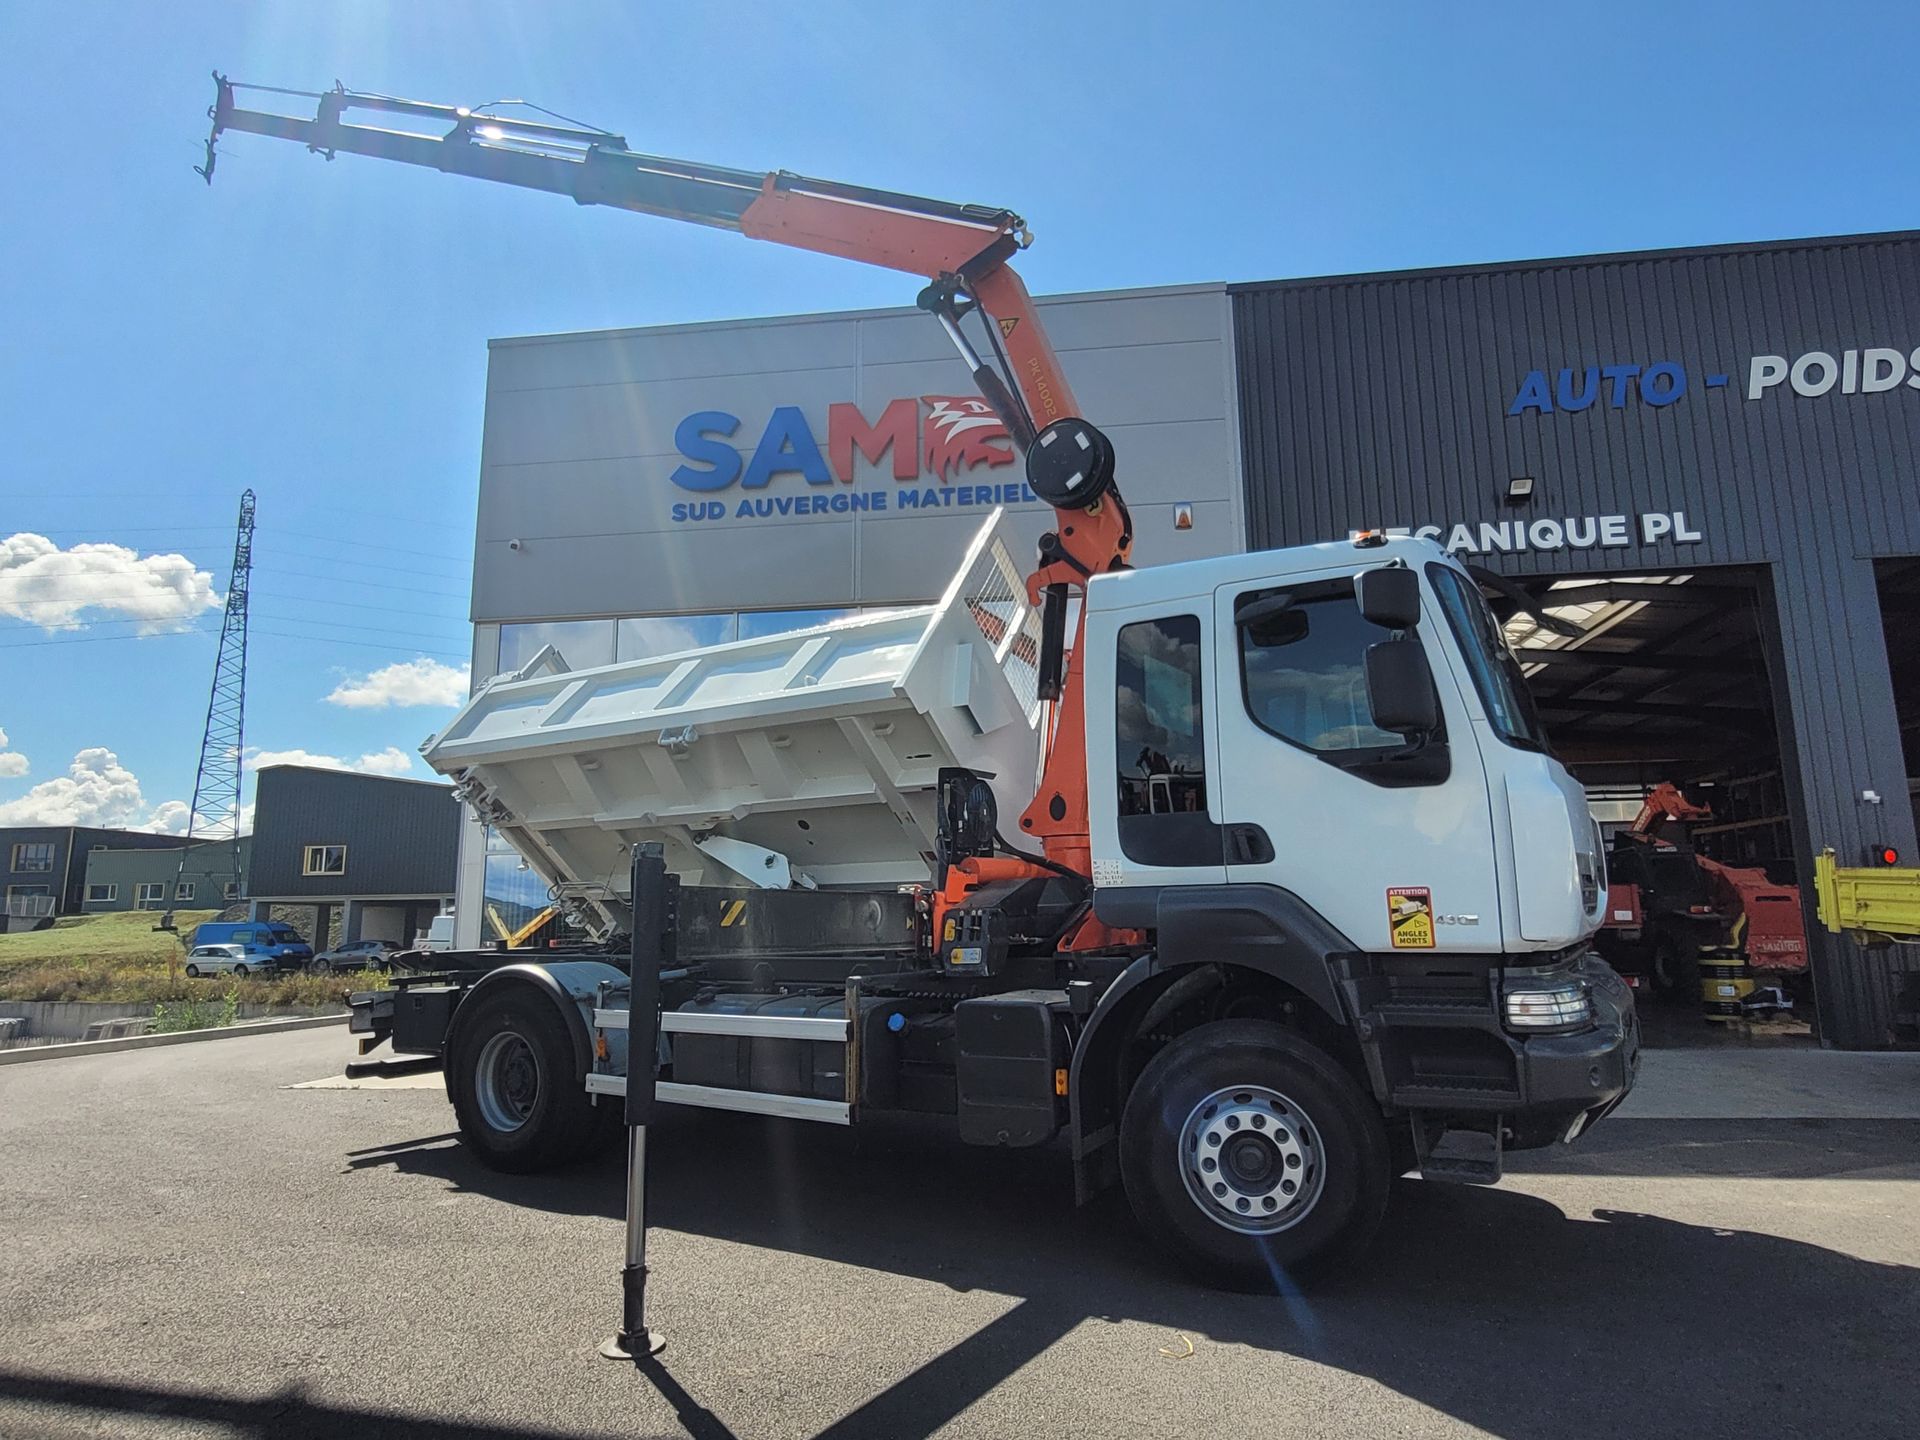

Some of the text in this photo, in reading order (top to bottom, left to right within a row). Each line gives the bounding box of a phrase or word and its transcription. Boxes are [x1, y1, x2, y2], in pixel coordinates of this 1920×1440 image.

[1027, 357, 1057, 417] PK 14002
[1508, 361, 1688, 416] AUTO
[670, 397, 919, 492] SAM
[671, 483, 1037, 522] SUD AUVERGNE MATERIEL
[1642, 511, 1702, 543] PL
[1389, 888, 1428, 896] ATTENTION
[1397, 930, 1428, 938] ANGLES
